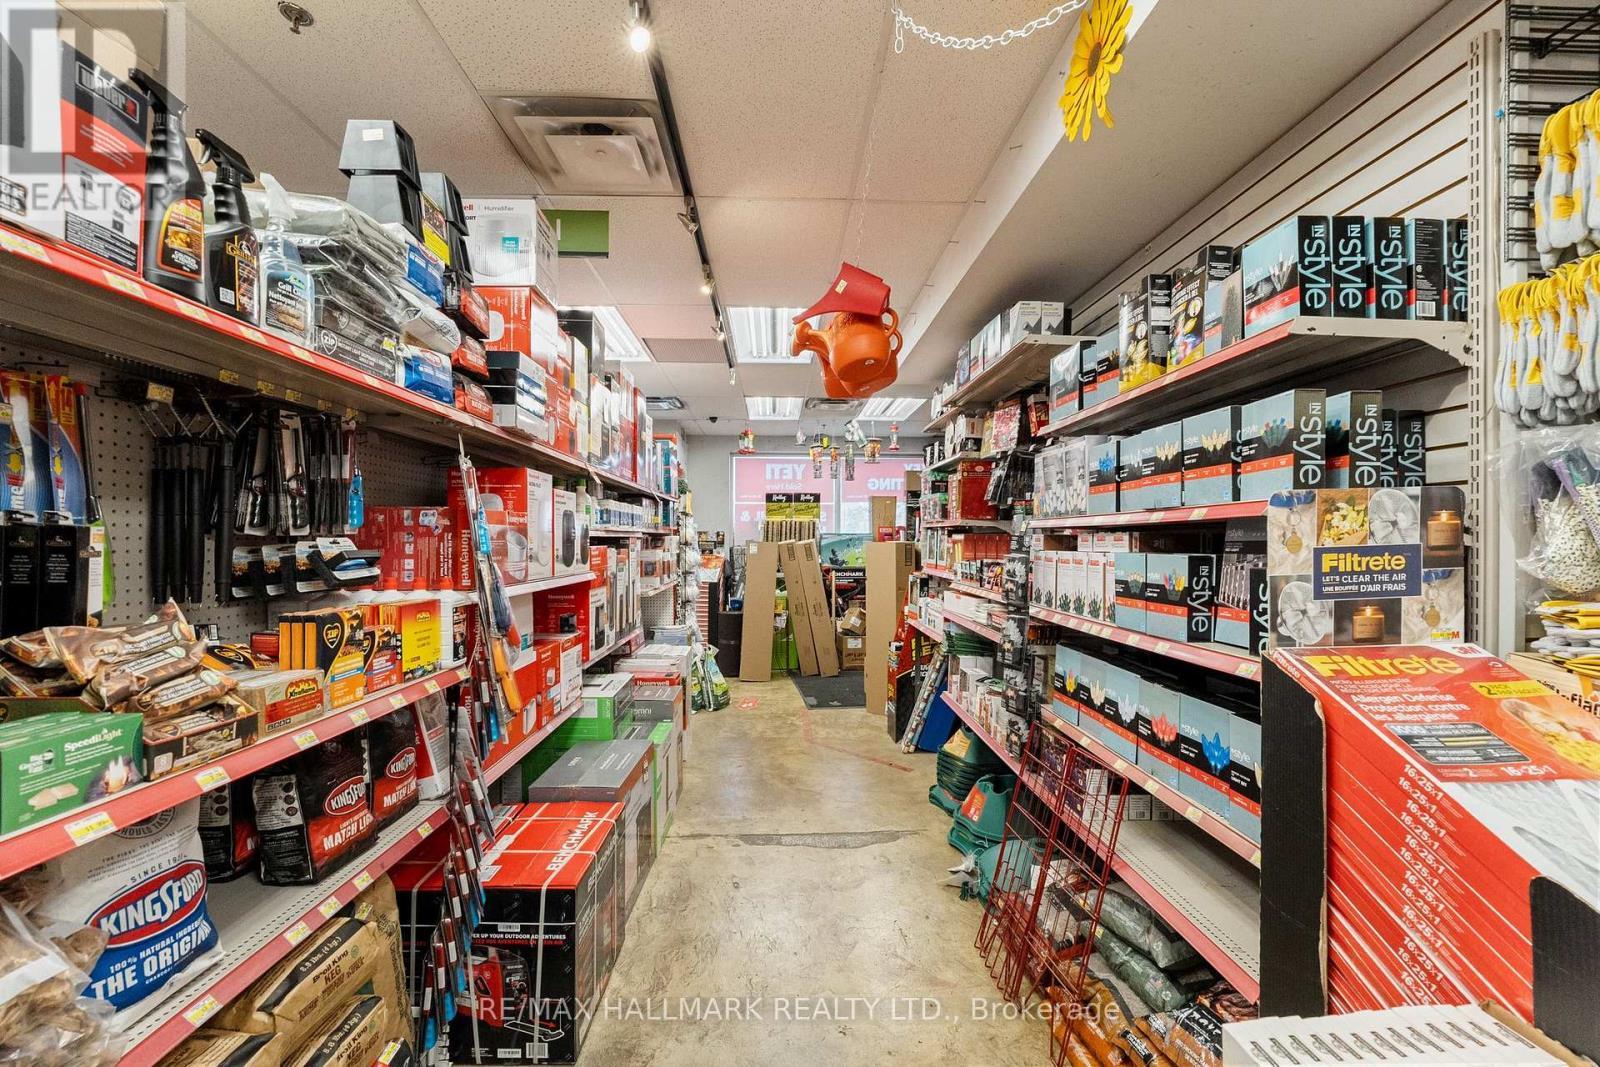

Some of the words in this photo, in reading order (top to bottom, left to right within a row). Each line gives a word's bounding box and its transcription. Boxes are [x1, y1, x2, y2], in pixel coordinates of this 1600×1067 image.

[1311, 225, 1324, 237] IN
[1347, 224, 1360, 237] IN
[1388, 225, 1401, 238] IN
[1299, 238, 1331, 309] Style
[1332, 238, 1366, 309] Style
[1374, 239, 1407, 310] Style
[1309, 402, 1321, 414] IN
[1365, 404, 1377, 416] IN
[1411, 421, 1422, 432] IN
[1293, 416, 1326, 485] Style
[1349, 417, 1382, 486] Style
[460, 529, 471, 586] Honeywell
[1322, 552, 1406, 573] Filtrete
[1199, 565, 1209, 577] IN
[1322, 574, 1340, 582] LET'S
[1341, 574, 1371, 583] CLEAR
[1373, 573, 1389, 582] THE
[1391, 573, 1407, 582] AIR
[1360, 583, 1381, 592] D'AIR
[1383, 582, 1407, 591] FRAIS
[1187, 577, 1214, 633] Style
[326, 629, 338, 638] ZIP
[1303, 654, 1464, 677] Filtrete
[1351, 694, 1402, 704] Allergen
[1404, 694, 1457, 702] Defense
[1479, 685, 1497, 695] 2
[1360, 704, 1427, 714] Protection
[1429, 704, 1471, 712] contre
[383, 785, 407, 807] MATCH
[323, 822, 357, 851] MATCH
[546, 811, 599, 872] BENCHMARK
[131, 862, 164, 883] SINCE
[100, 868, 202, 937] KINGSFORD
[140, 936, 175, 959] NATURAL
[333, 949, 349, 963] King
[91, 964, 138, 1000] THE
[324, 964, 341, 985] KEG
[353, 1025, 367, 1041] King
